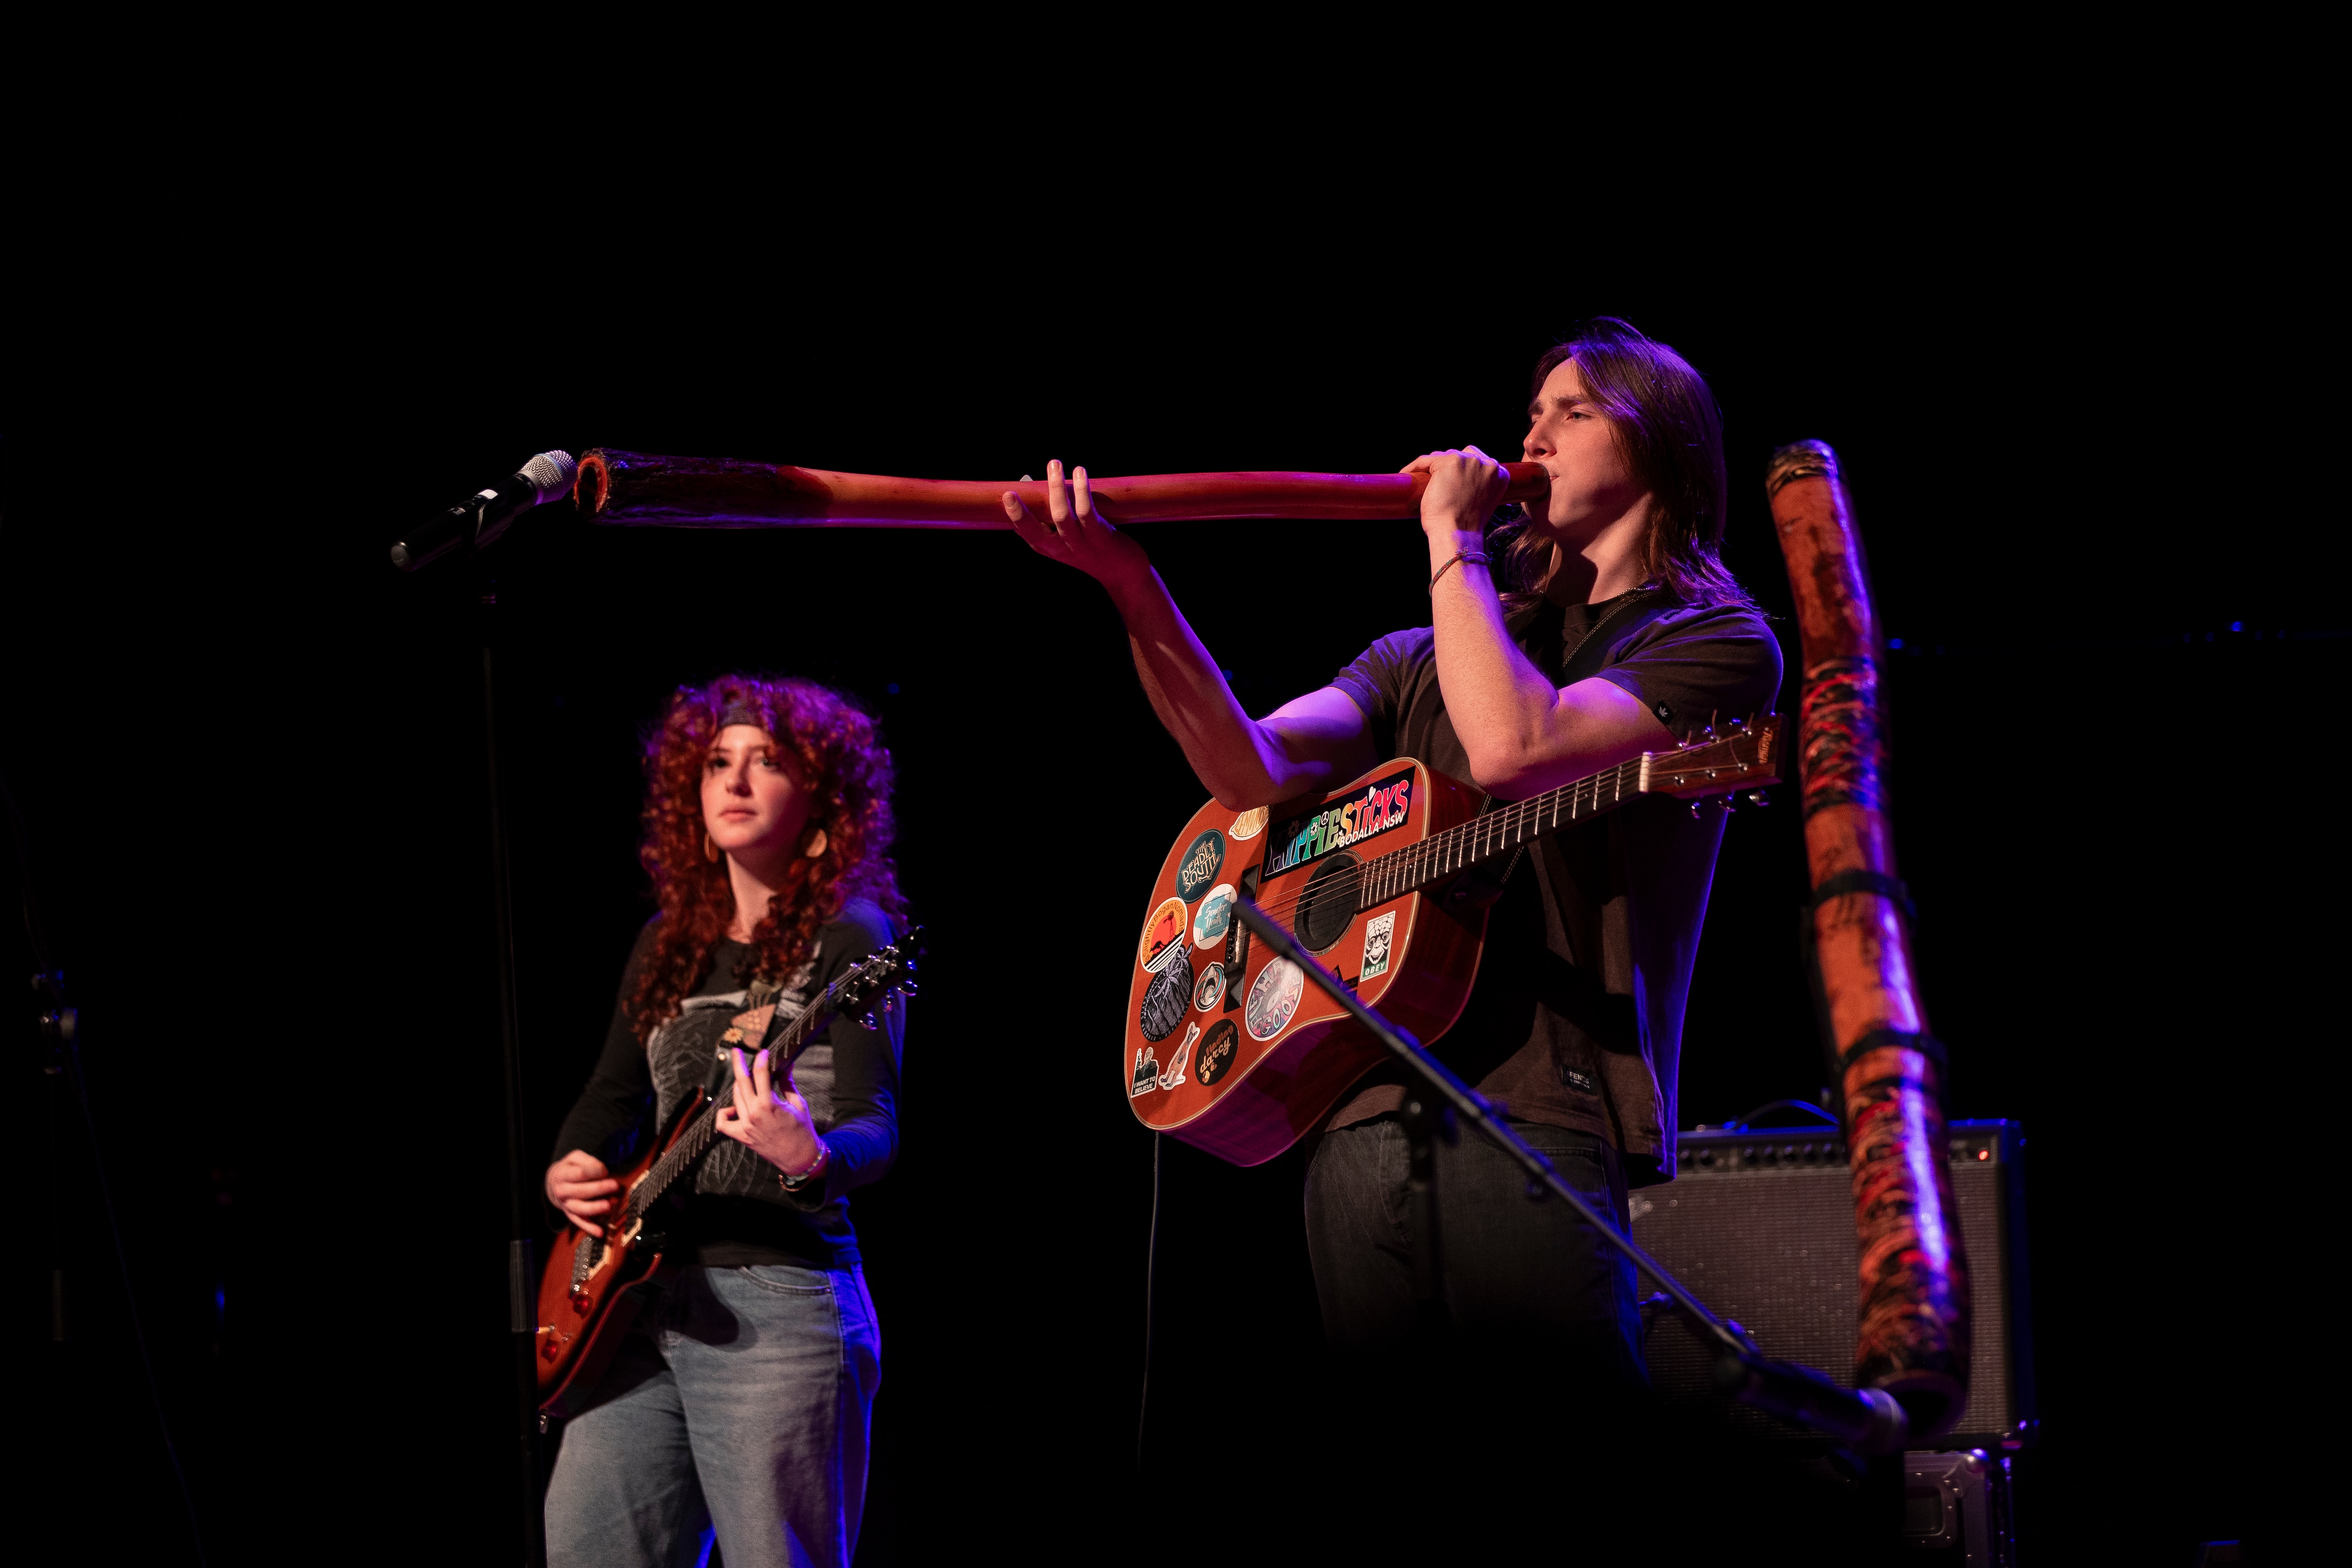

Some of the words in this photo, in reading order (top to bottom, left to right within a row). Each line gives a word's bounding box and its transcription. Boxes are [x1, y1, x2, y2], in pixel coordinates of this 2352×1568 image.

[1195, 841, 1207, 854] THE
[1339, 824, 1379, 848] BODALLA
[1383, 811, 1405, 830] NSW
[1181, 837, 1216, 884] DEADLY
[1184, 852, 1221, 894] SOUTH
[1365, 962, 1385, 976] OBEY
[1200, 1036, 1231, 1074] darcy
[1134, 1082, 1153, 1094] BELIEVE
